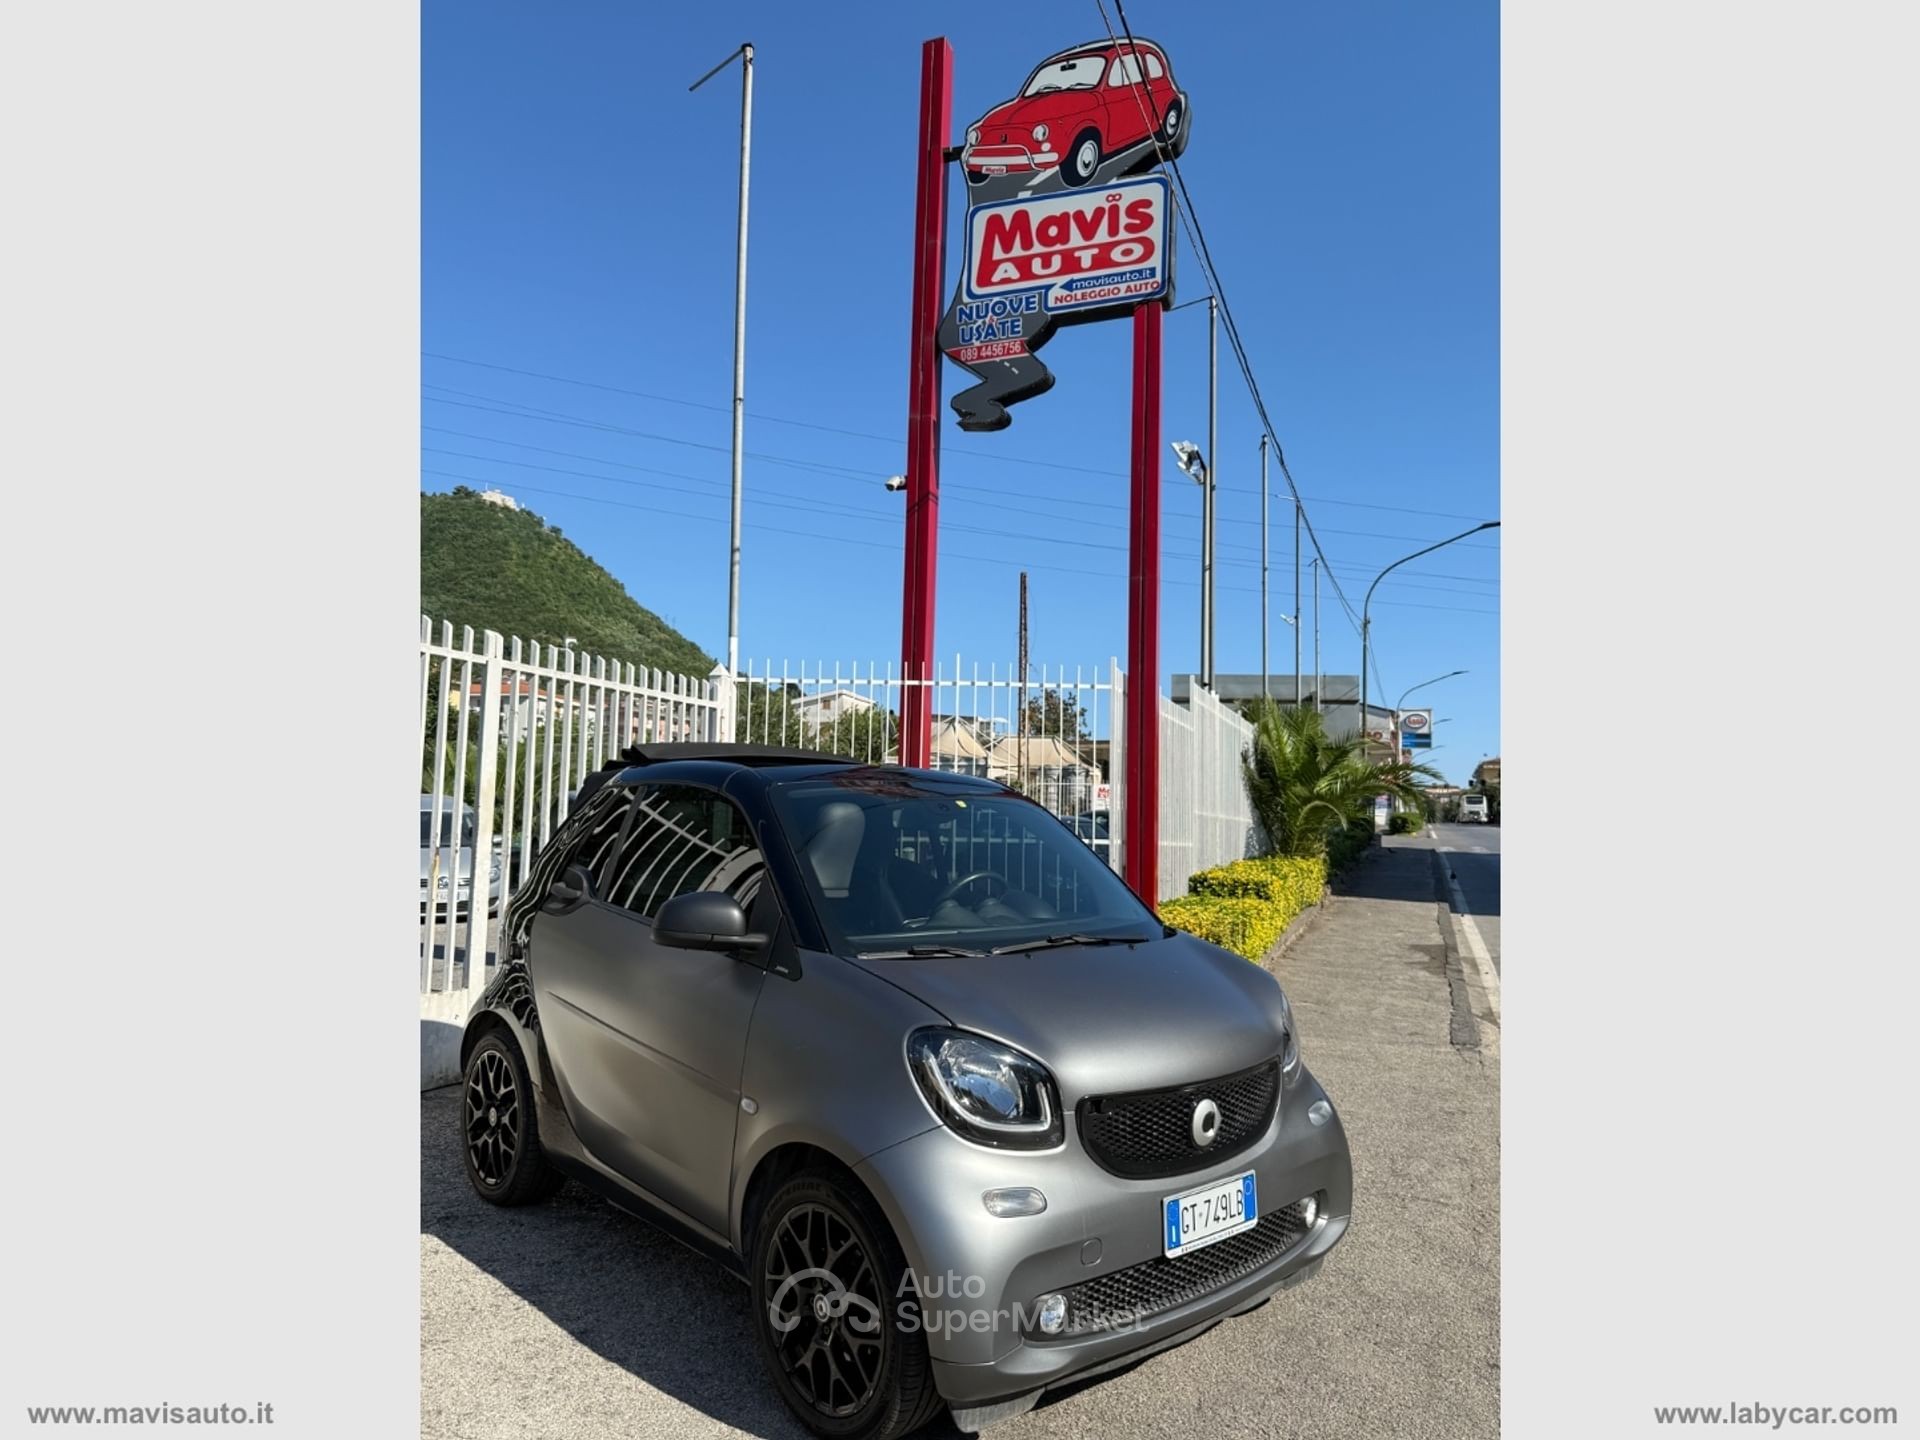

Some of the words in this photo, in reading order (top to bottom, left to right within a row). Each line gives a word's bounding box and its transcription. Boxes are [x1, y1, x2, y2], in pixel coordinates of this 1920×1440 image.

[991, 242, 1145, 283] AUTO
[1054, 286, 1122, 305] NOLEGGIO
[1125, 280, 1161, 295] AUTO
[1073, 269, 1153, 290] mavisauto.it
[957, 295, 1038, 324] NUOVE
[959, 318, 1023, 345] USATE
[960, 346, 978, 361] 089
[979, 341, 1022, 359] 4456756
